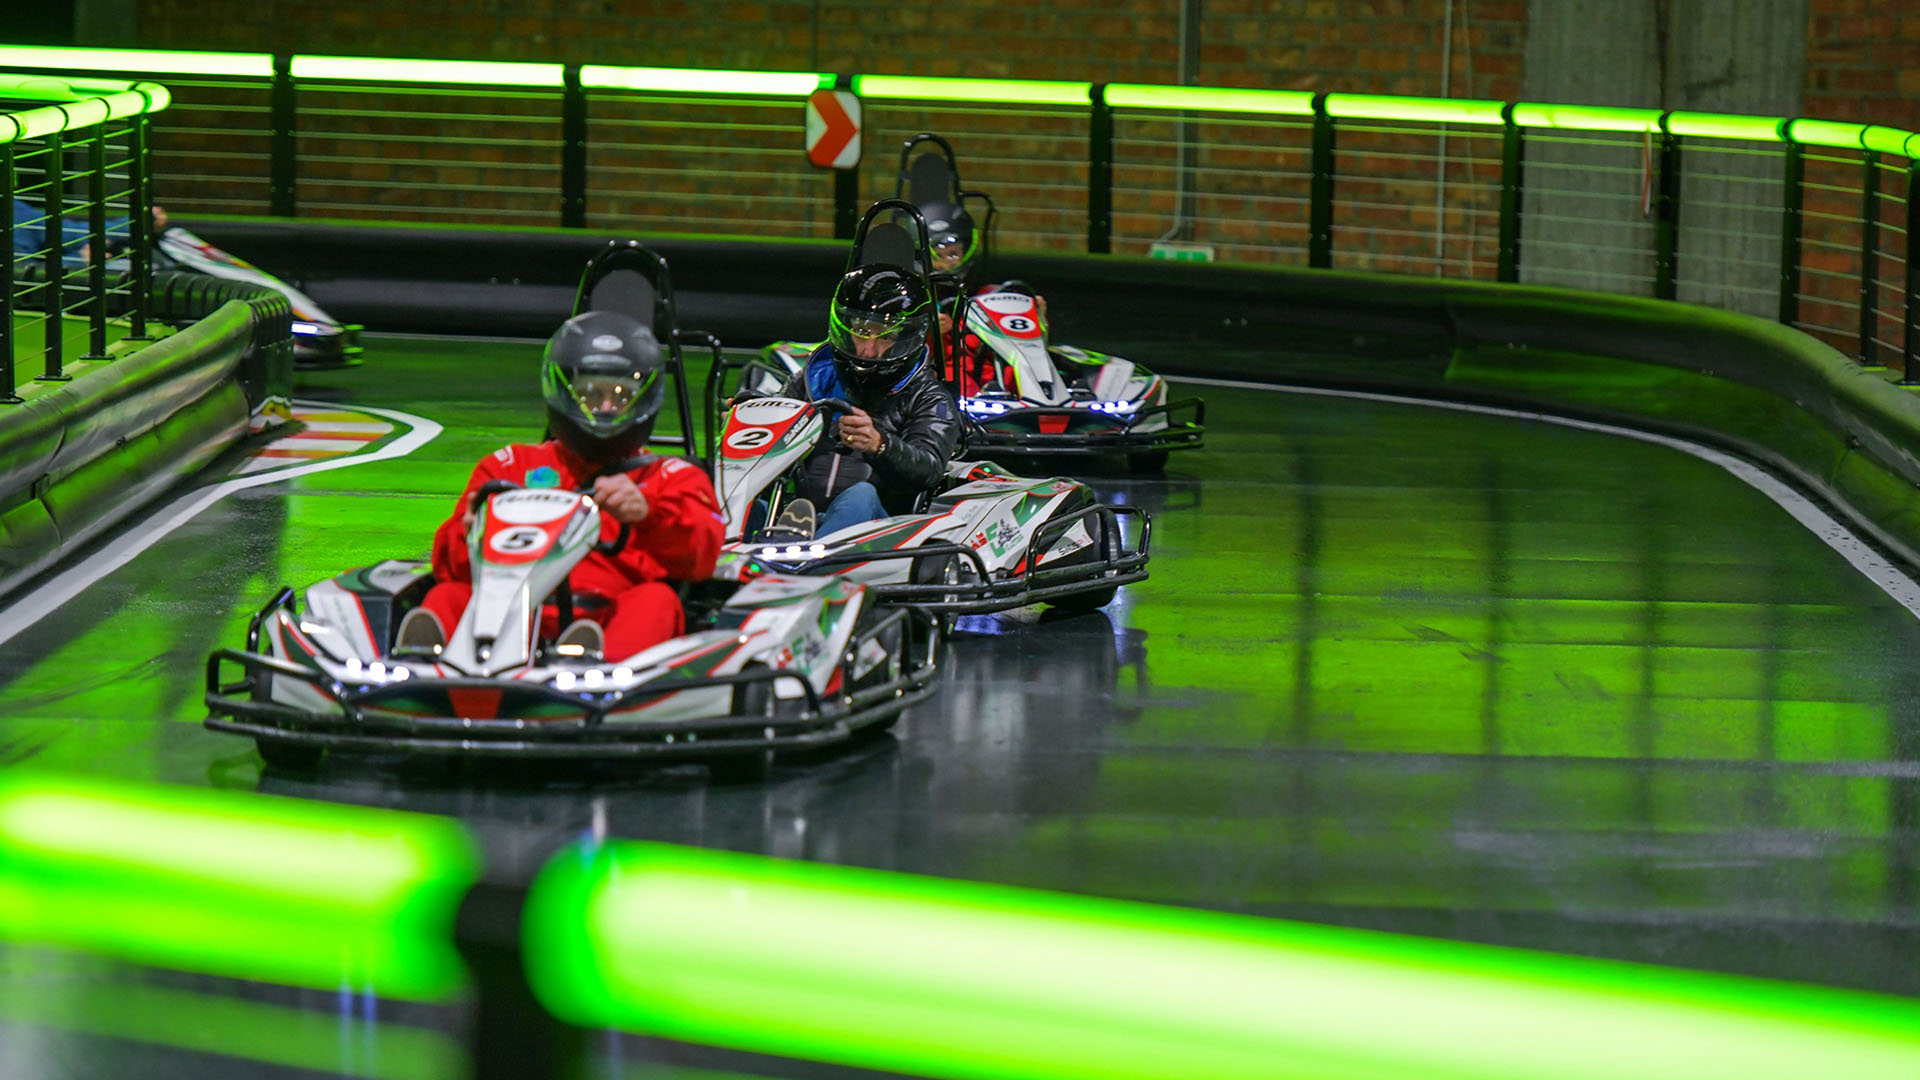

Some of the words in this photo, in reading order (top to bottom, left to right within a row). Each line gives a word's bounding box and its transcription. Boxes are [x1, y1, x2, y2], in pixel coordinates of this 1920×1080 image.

[1009, 318, 1029, 330] 8
[733, 431, 769, 446] 2
[501, 531, 538, 549] 5
